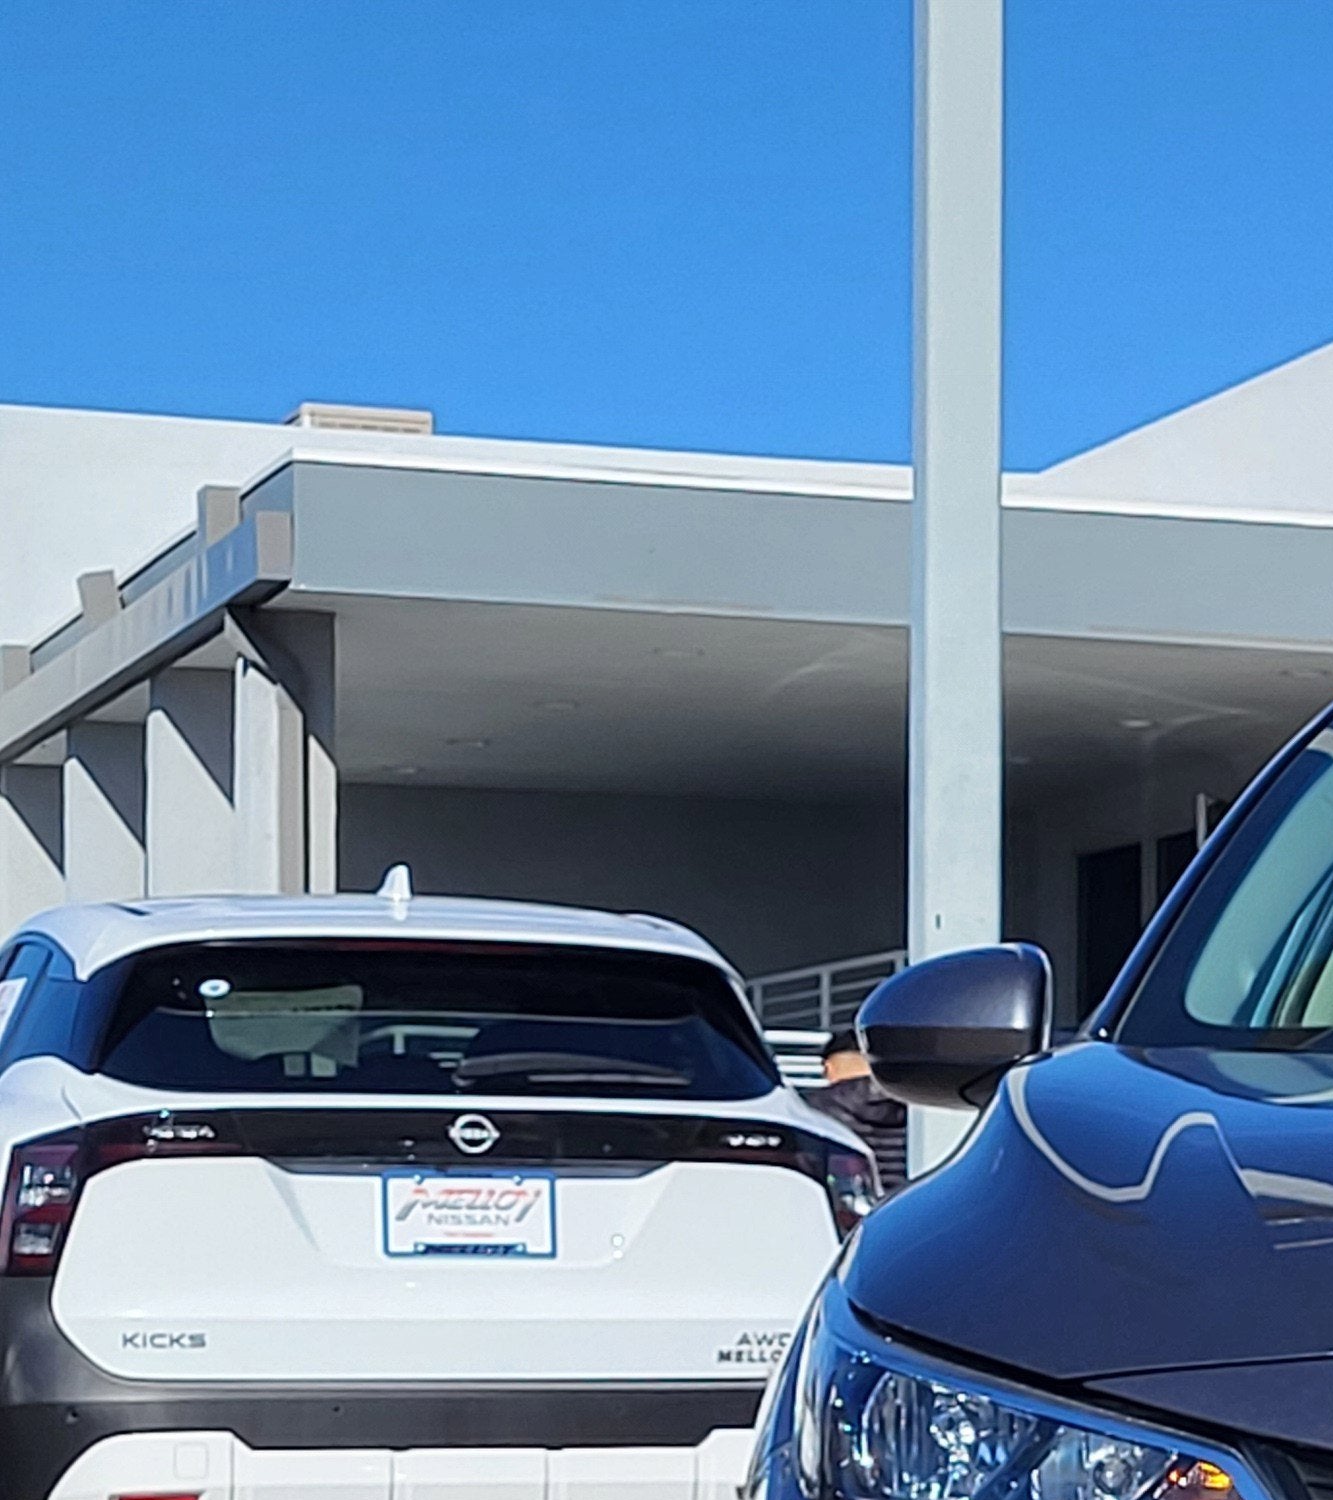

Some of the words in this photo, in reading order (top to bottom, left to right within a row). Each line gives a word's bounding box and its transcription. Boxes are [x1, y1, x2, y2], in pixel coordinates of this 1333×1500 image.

[427, 1212, 511, 1227] NISSAN
[121, 1332, 207, 1349] KICKS
[718, 1349, 783, 1362] MELLO
